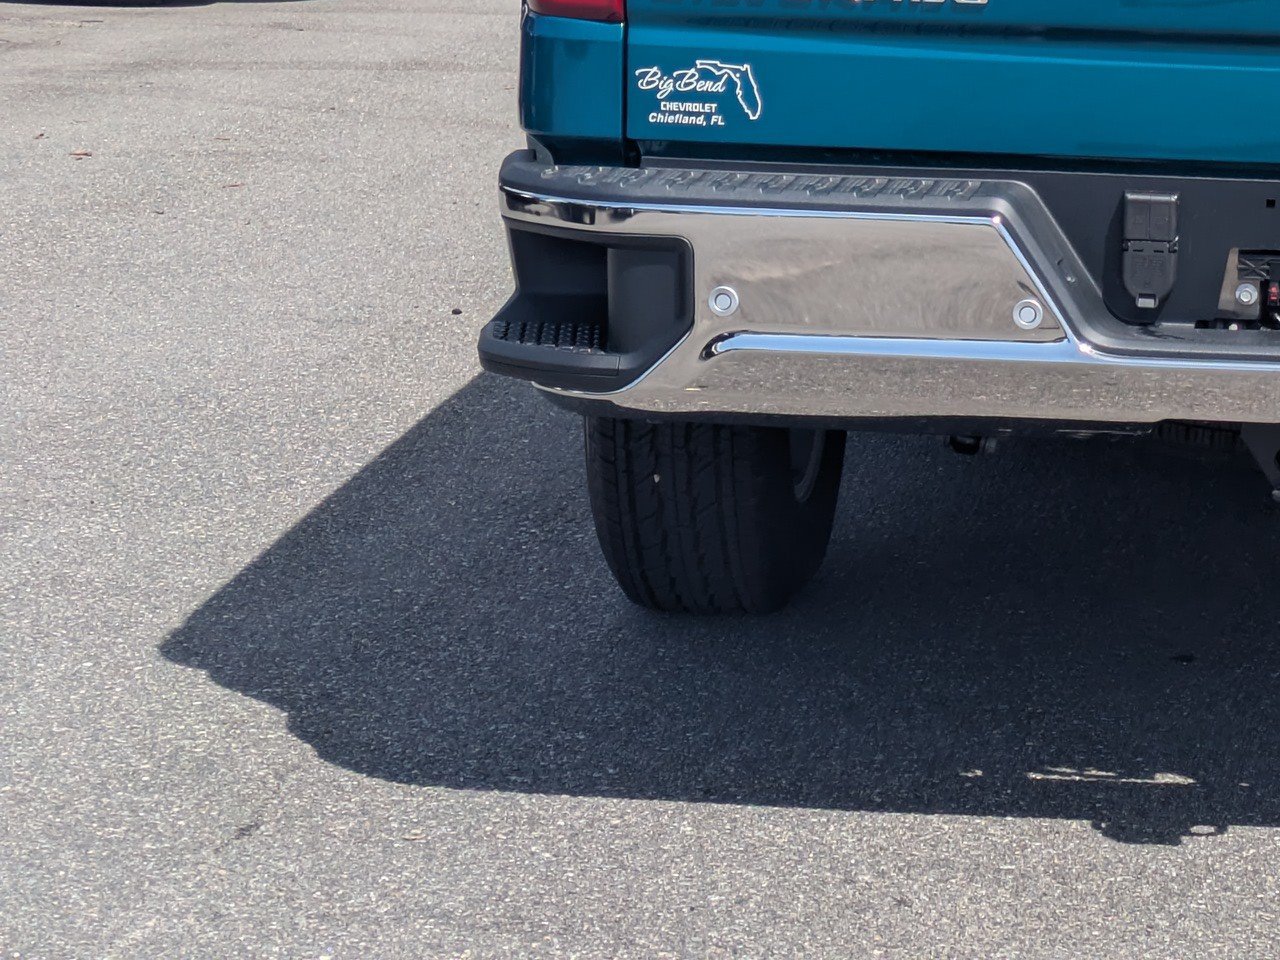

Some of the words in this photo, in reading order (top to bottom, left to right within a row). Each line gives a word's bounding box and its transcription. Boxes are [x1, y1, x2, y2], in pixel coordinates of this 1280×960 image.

[635, 66, 674, 99] Big
[673, 68, 728, 93] Bend
[660, 101, 718, 113] CHEVROLET
[648, 112, 707, 127] Chiefland,
[710, 115, 725, 126] FL
